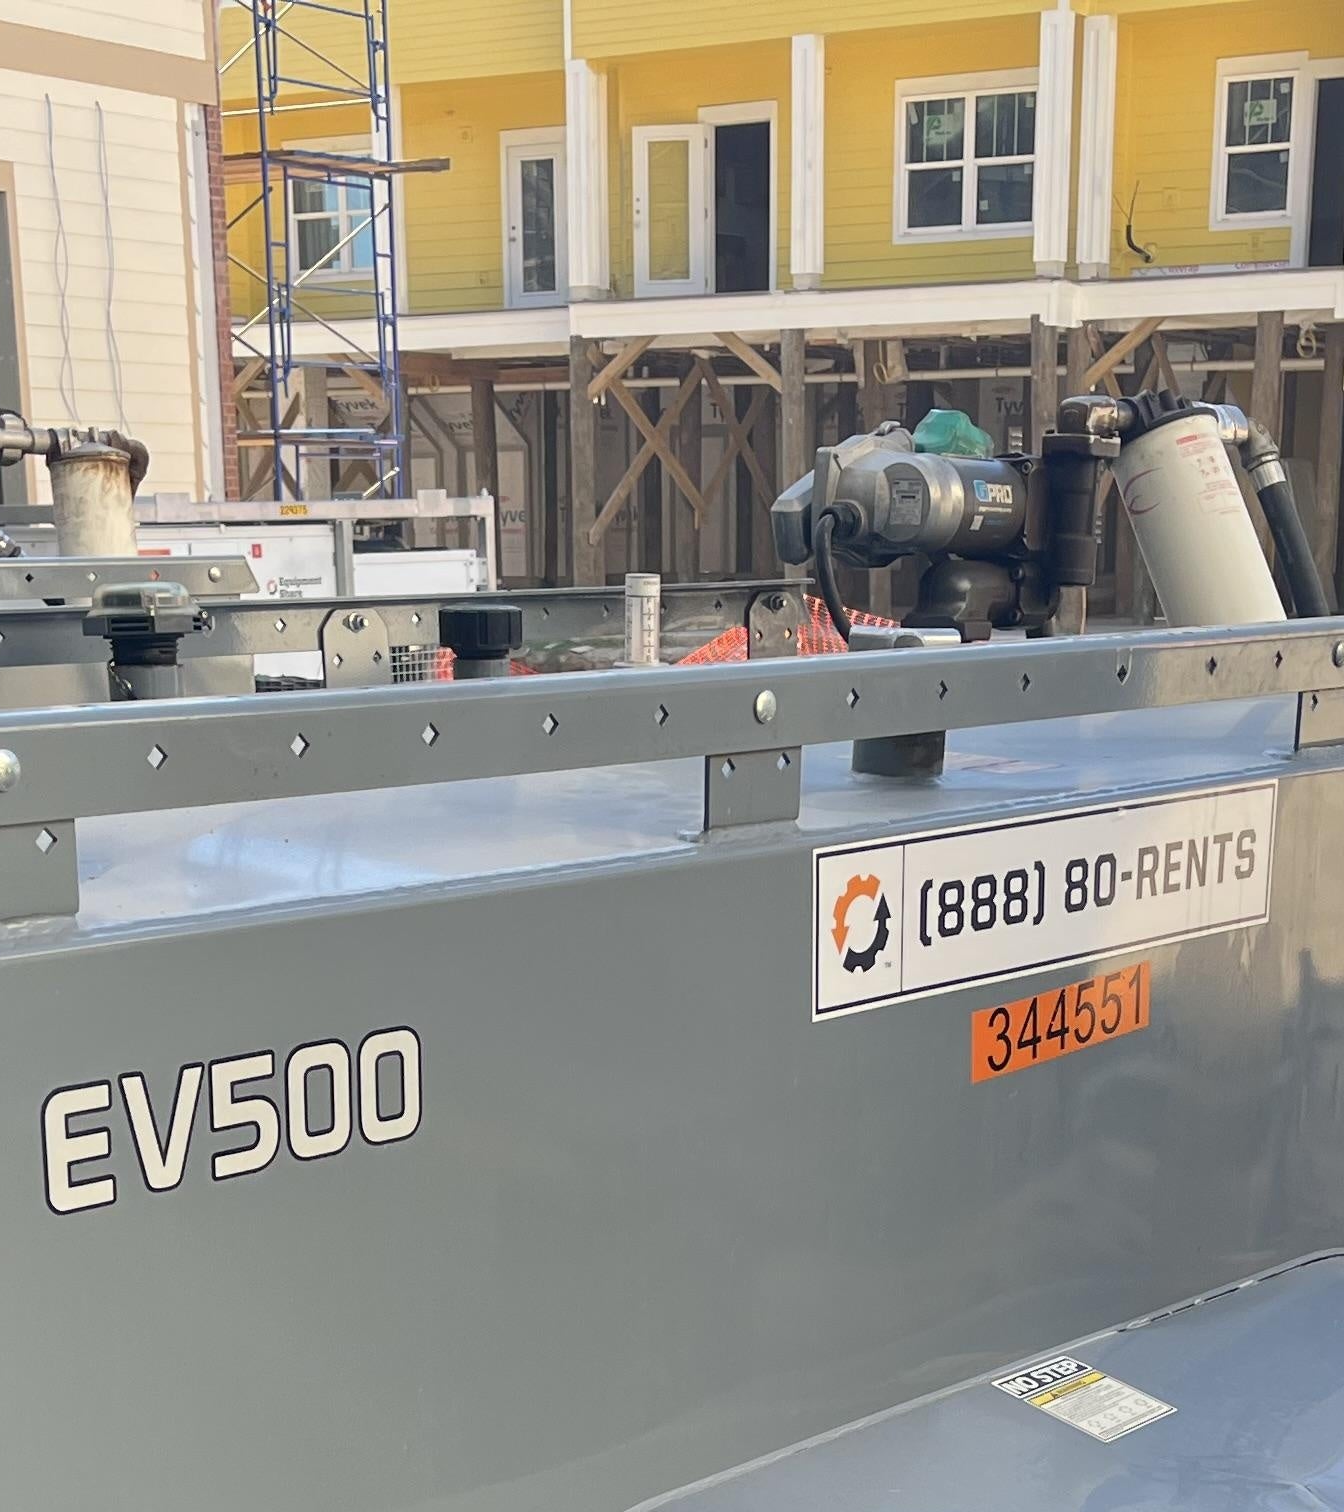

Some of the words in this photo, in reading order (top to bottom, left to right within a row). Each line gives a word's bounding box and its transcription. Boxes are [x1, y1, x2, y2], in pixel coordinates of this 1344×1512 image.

[279, 576, 322, 588] Equipment
[920, 860, 1045, 947] (888)
[1064, 828, 1256, 913] 80-RENTS
[988, 964, 1146, 1073] 344551
[41, 1025, 423, 1216] EV500
[1003, 1376, 1039, 1395] NO
[1035, 1358, 1081, 1384] STEP
